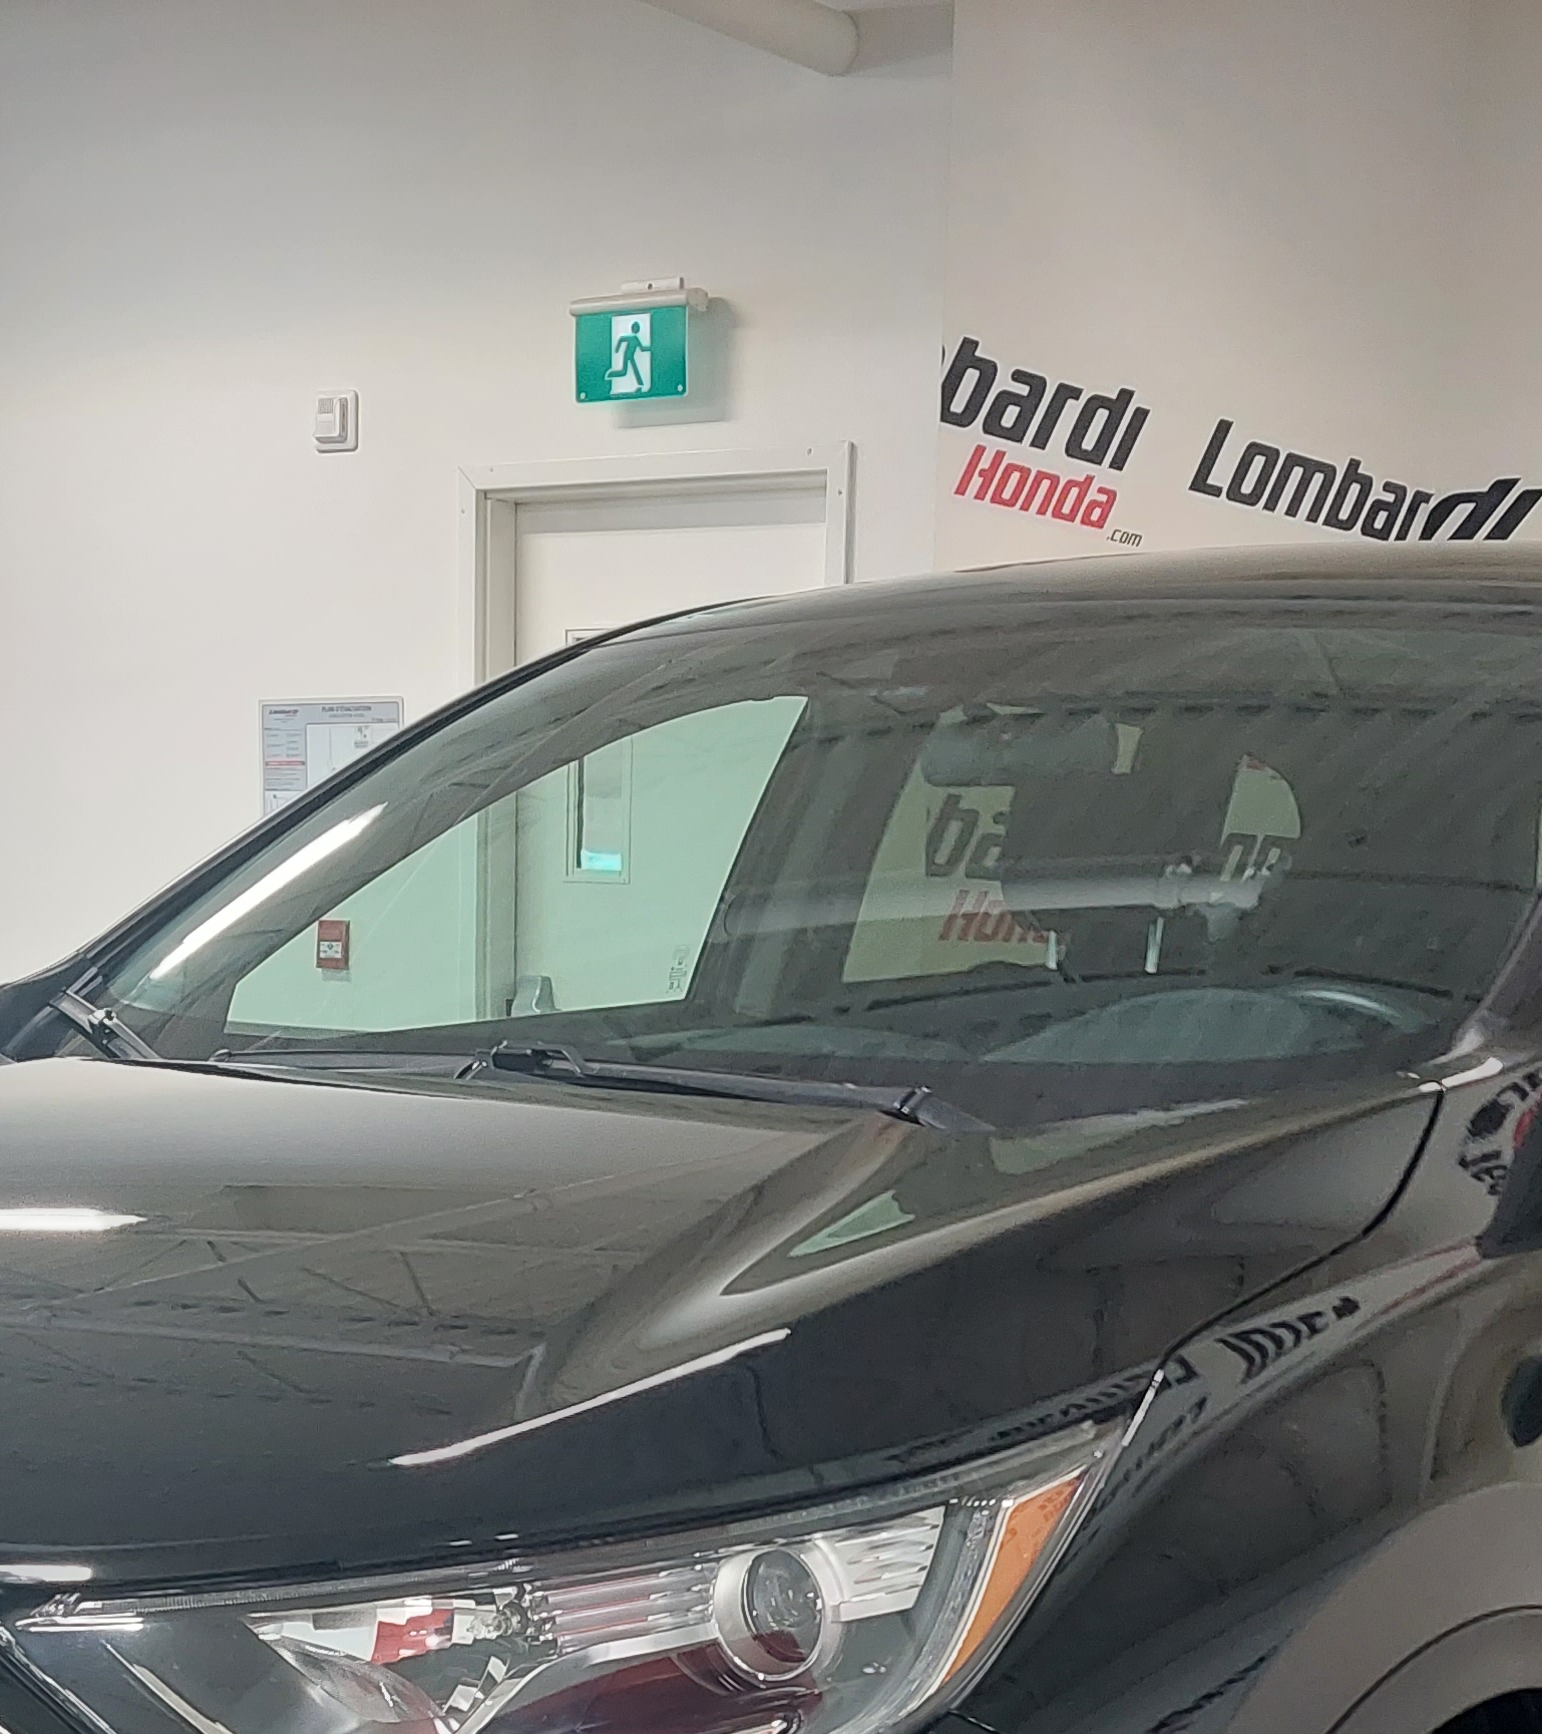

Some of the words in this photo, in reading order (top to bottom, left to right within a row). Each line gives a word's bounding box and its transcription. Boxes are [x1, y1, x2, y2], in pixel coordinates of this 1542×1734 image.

[941, 336, 1151, 472] bardi
[953, 444, 1117, 529] Honda
[1106, 529, 1143, 547] .com
